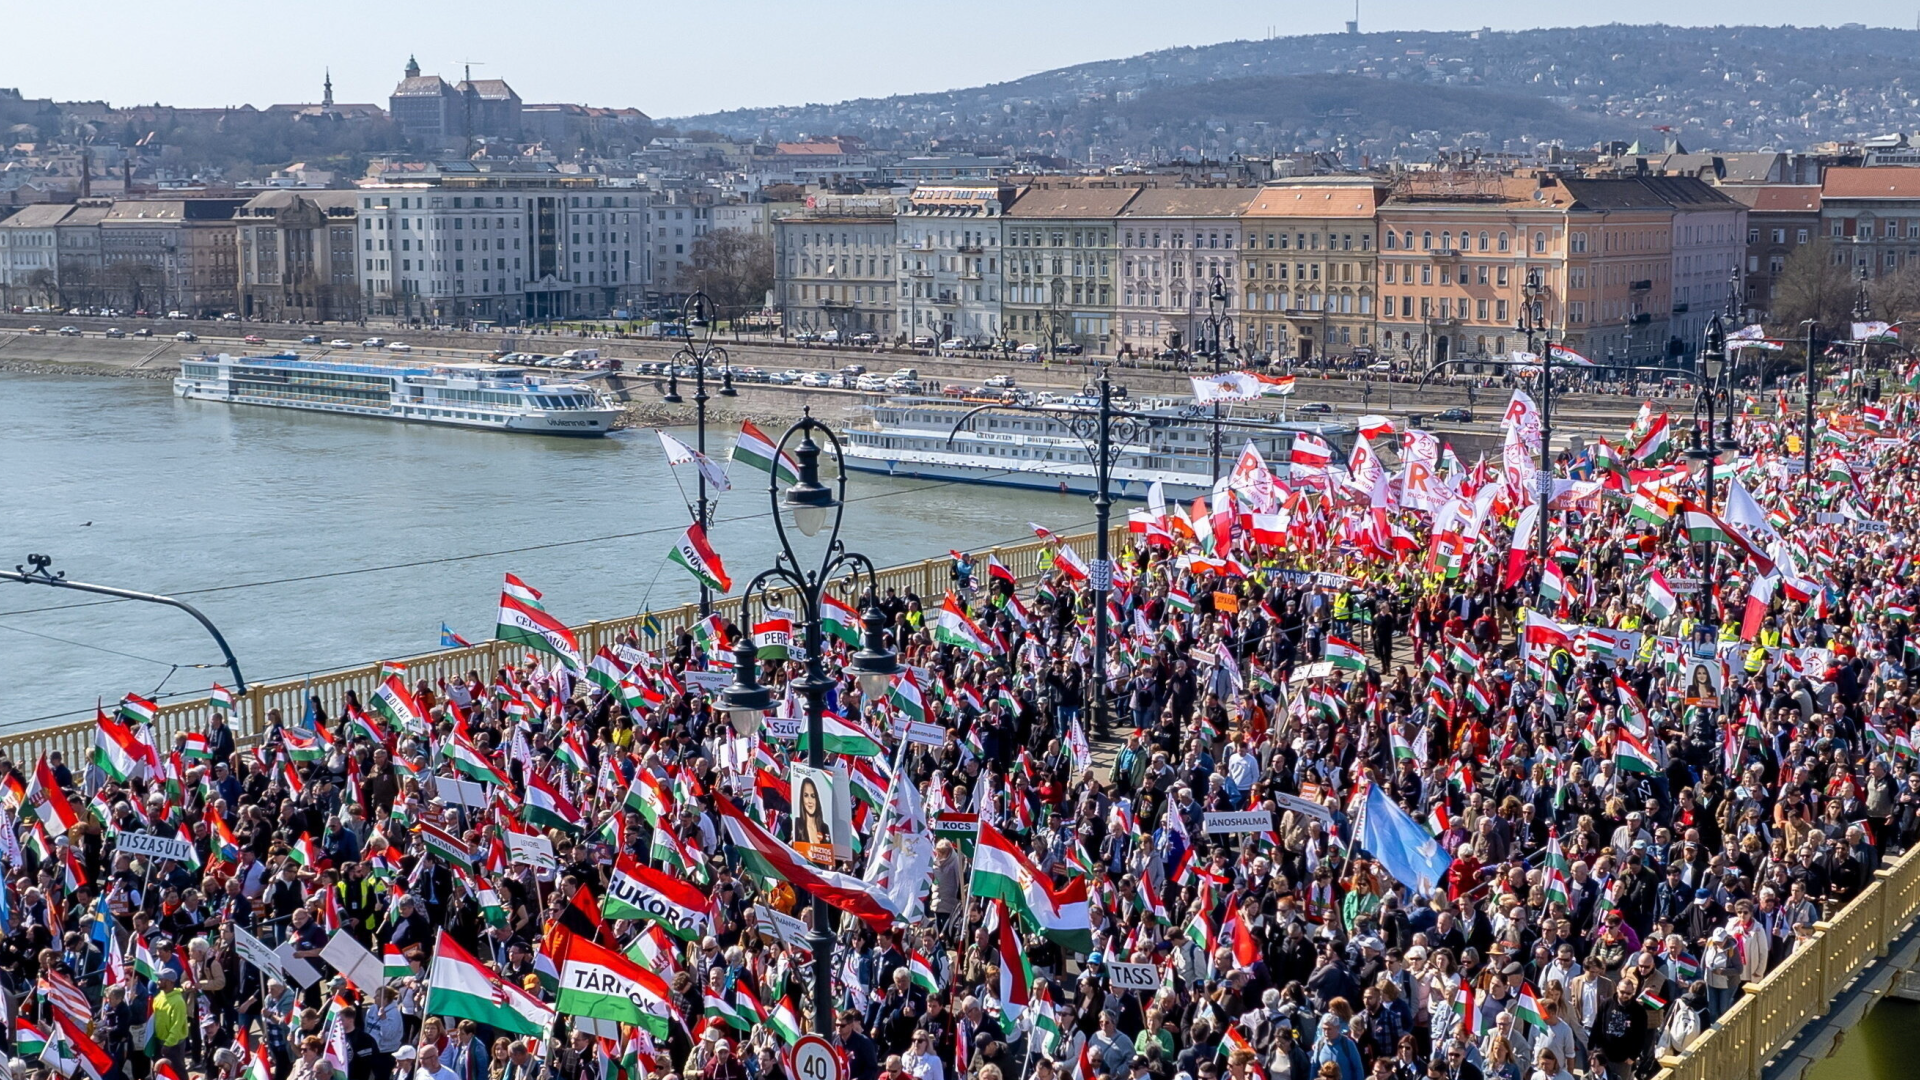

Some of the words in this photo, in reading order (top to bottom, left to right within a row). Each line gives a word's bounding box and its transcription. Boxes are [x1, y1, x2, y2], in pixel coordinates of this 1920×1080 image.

[1858, 522, 1886, 532] PÉCS
[942, 822, 972, 830] KOCS
[1208, 817, 1269, 827] JÁNOSHALMA
[119, 833, 190, 858] TISZASÜLY
[1111, 966, 1154, 985] TASS
[803, 1054, 827, 1079] 40
